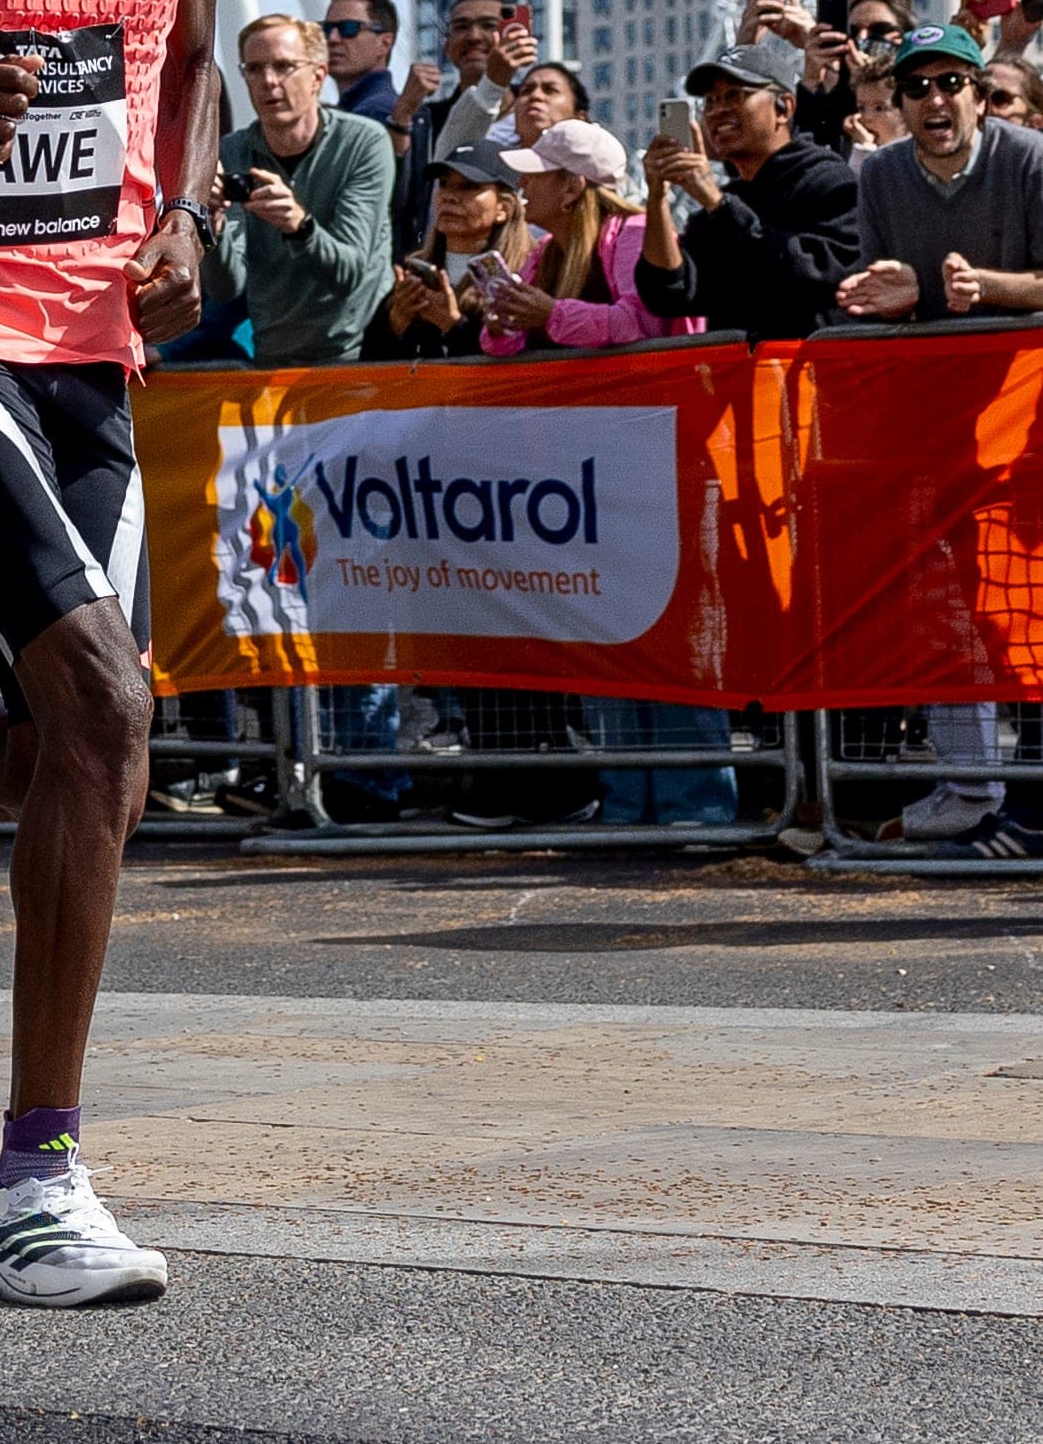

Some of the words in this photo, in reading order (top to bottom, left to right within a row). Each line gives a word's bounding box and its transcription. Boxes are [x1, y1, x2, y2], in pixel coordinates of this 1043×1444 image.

[16, 44, 62, 59] TATA
[34, 215, 100, 235] balance
[315, 455, 598, 545] Voltarol
[335, 558, 381, 587] The
[383, 557, 420, 592] joy
[426, 559, 450, 588] of
[456, 567, 602, 596] movement
